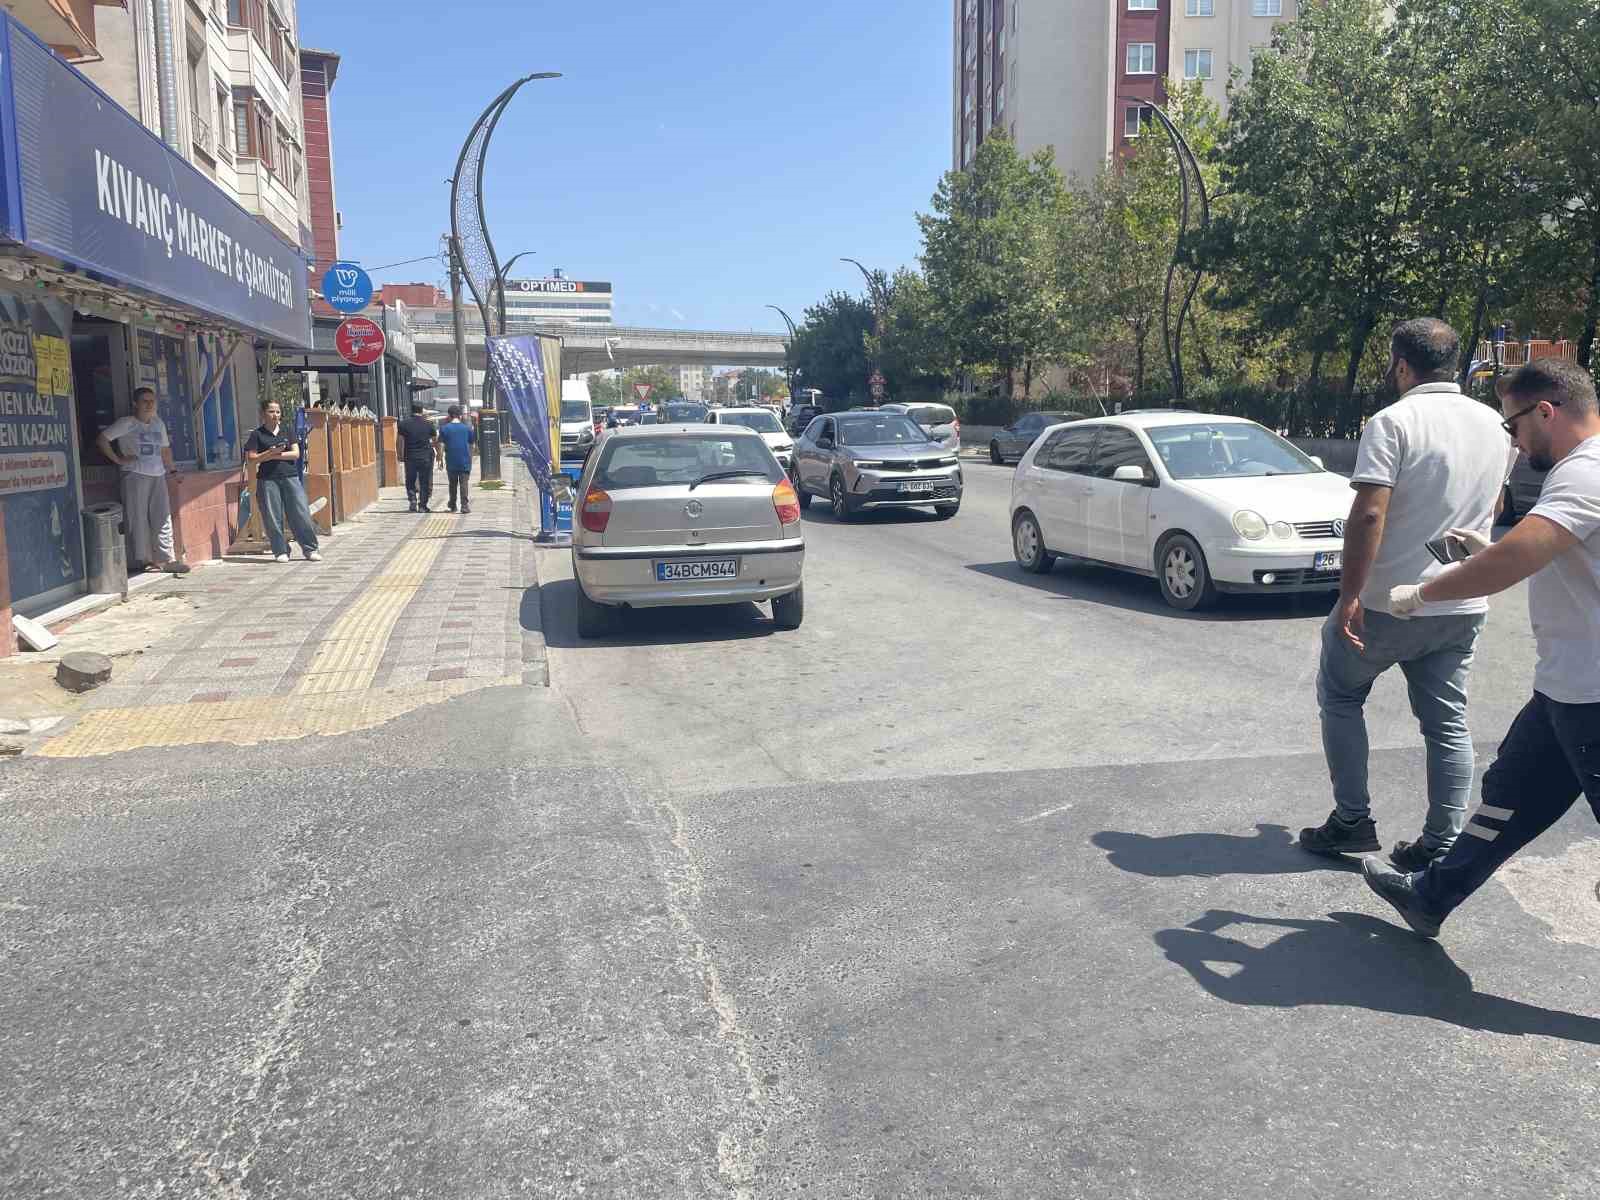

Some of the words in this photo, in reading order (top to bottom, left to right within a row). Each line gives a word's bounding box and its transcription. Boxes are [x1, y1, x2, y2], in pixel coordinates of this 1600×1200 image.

[96, 149, 173, 258] KIVANÇ
[176, 203, 232, 276] MARKET
[235, 242, 244, 284] &
[244, 248, 293, 309] ŞARKÜTERİ
[665, 561, 735, 578] 34BCM944
